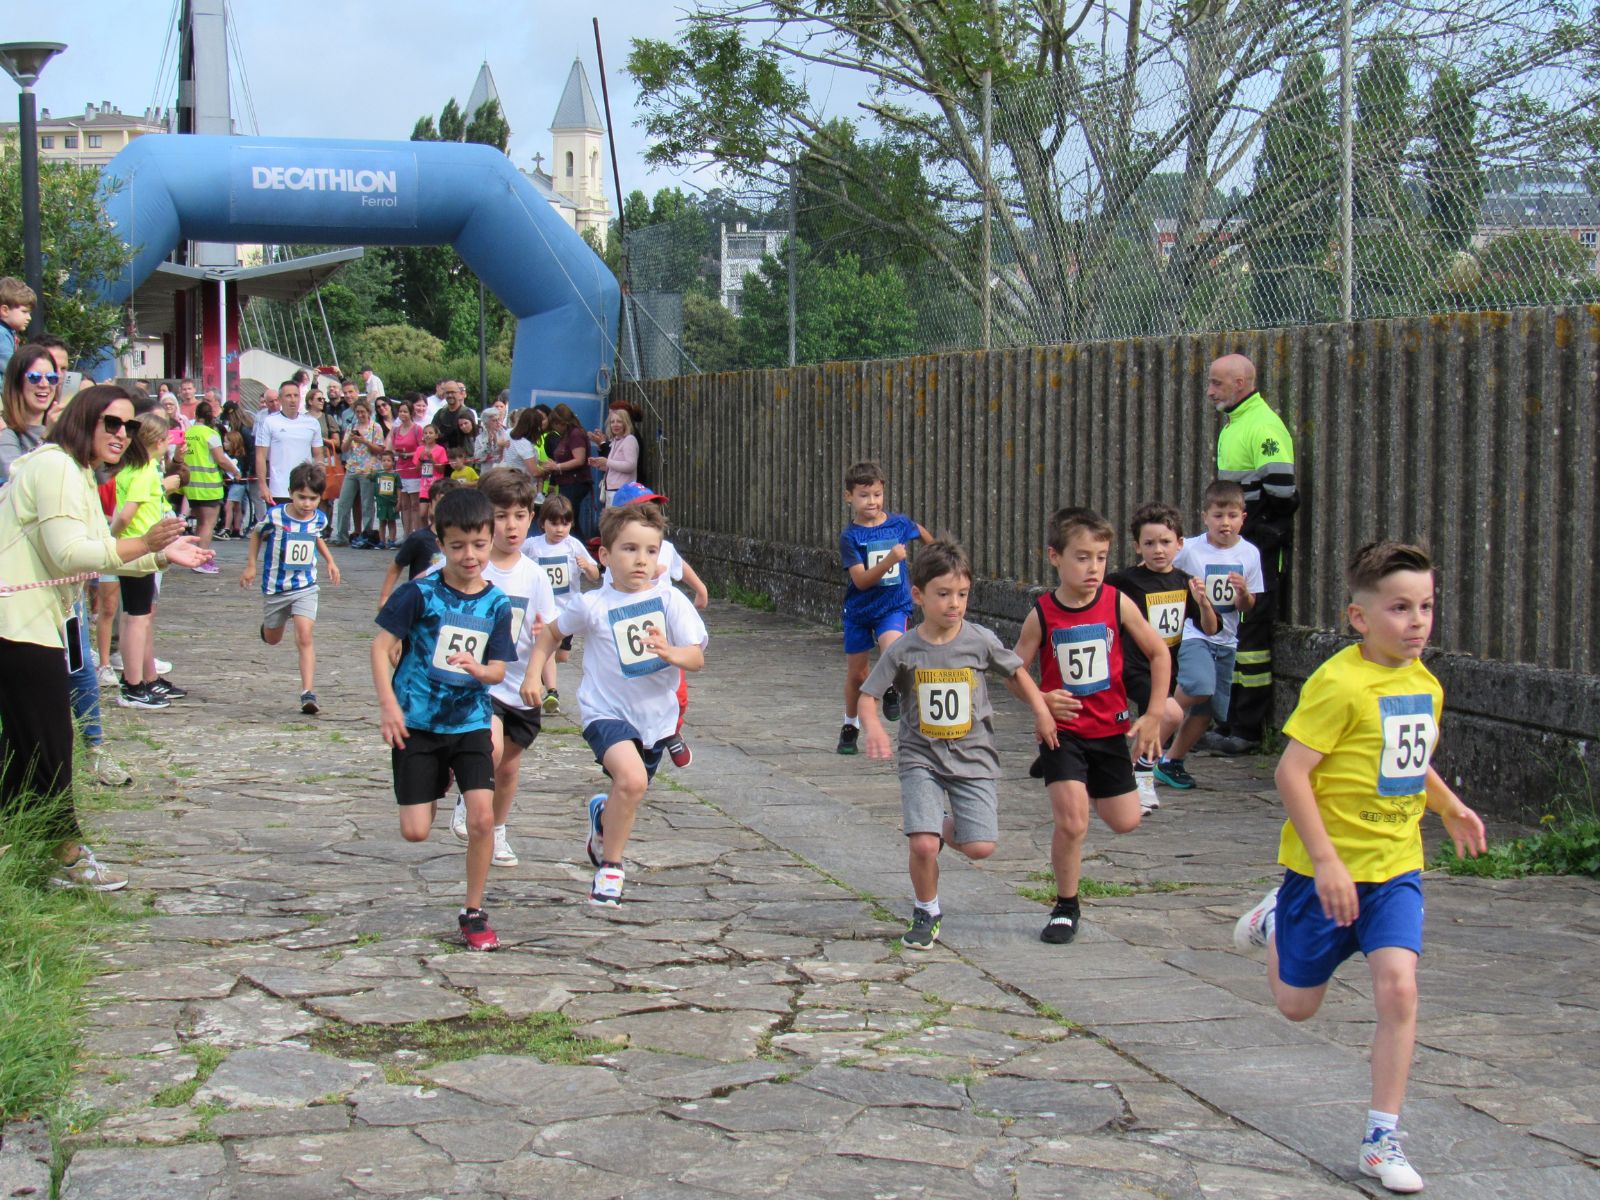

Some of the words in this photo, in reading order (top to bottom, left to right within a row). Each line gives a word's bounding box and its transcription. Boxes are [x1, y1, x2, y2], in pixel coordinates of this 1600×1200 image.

[252, 166, 397, 193] DECATHLON
[361, 195, 398, 207] Ferrol
[383, 481, 392, 491] 15
[292, 544, 308, 562] 60
[546, 567, 563, 585] 59
[1212, 578, 1234, 602] 65
[1159, 607, 1180, 634] 43
[1068, 645, 1096, 680] 57
[917, 671, 933, 684] VIII
[929, 688, 959, 721] 50
[1396, 723, 1426, 770] 55
